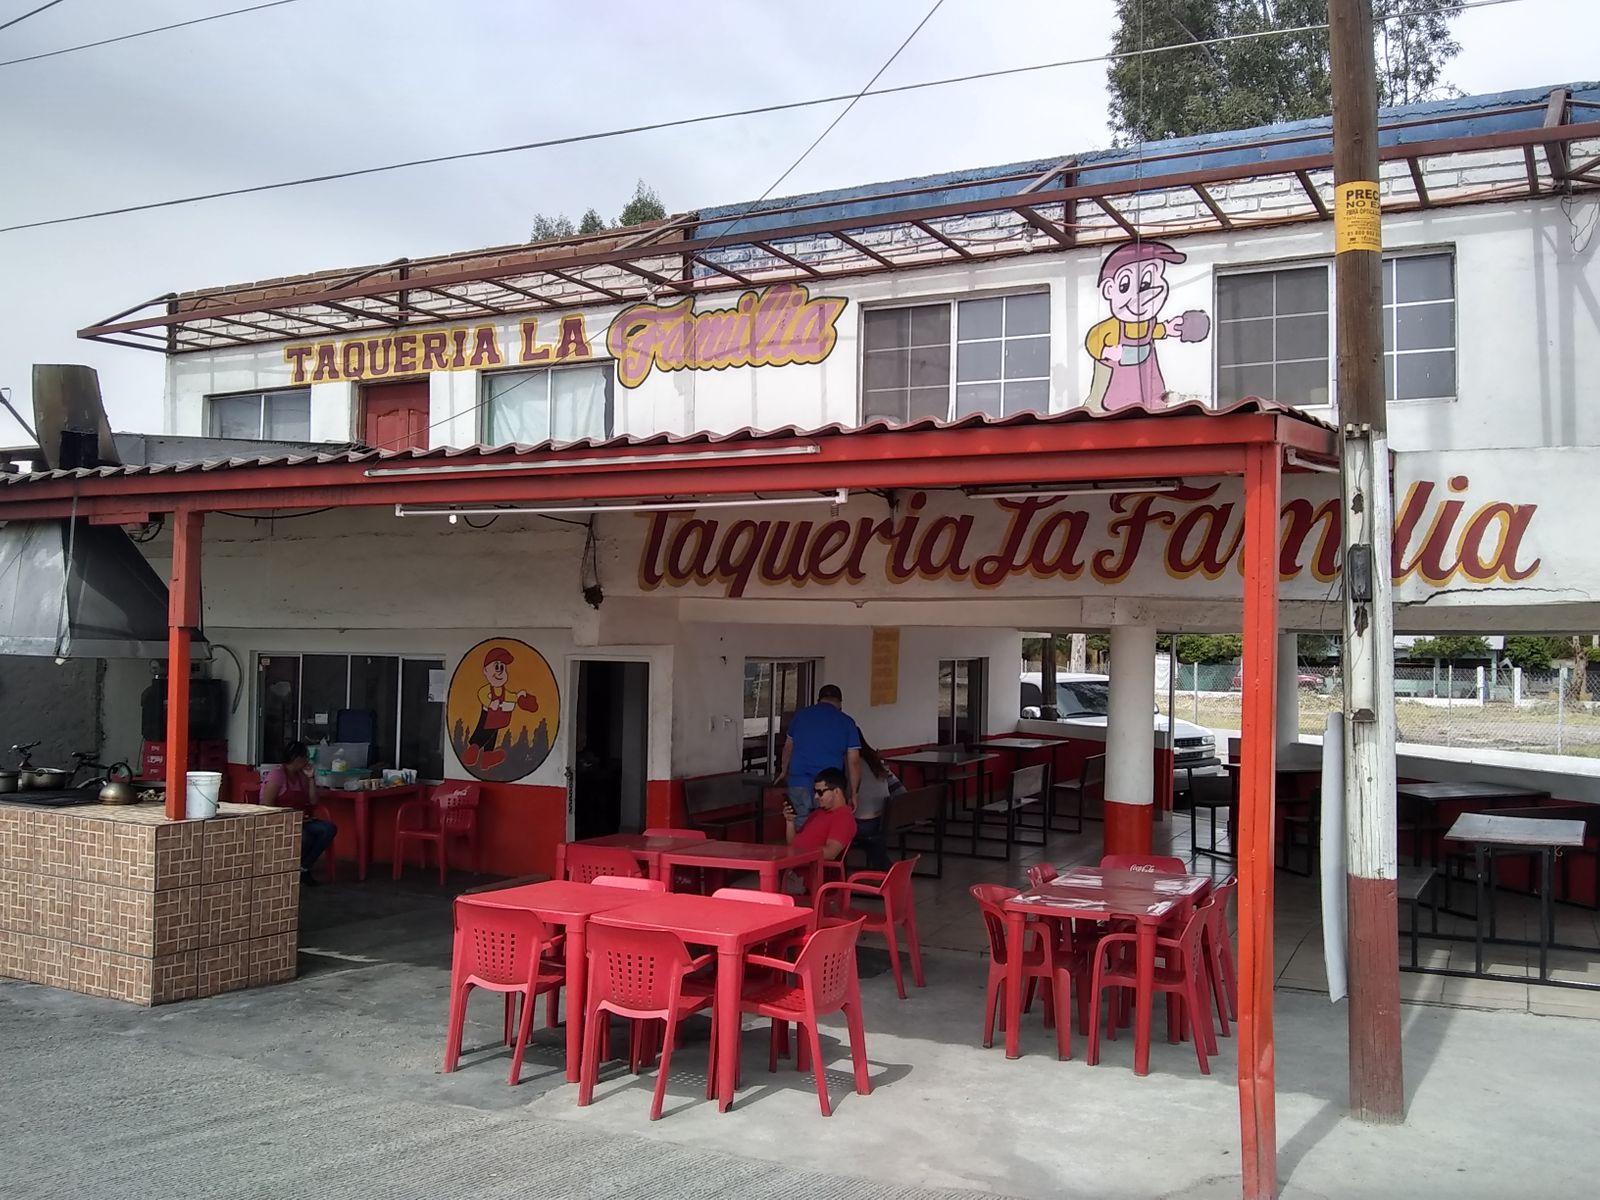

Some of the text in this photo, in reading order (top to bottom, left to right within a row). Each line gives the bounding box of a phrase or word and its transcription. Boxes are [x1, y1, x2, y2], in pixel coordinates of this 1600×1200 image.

[1346, 200, 1366, 209] NO
[284, 284, 848, 388] TAQUERIA LA Familia
[636, 475, 1541, 598] Taqueria La Famlia
